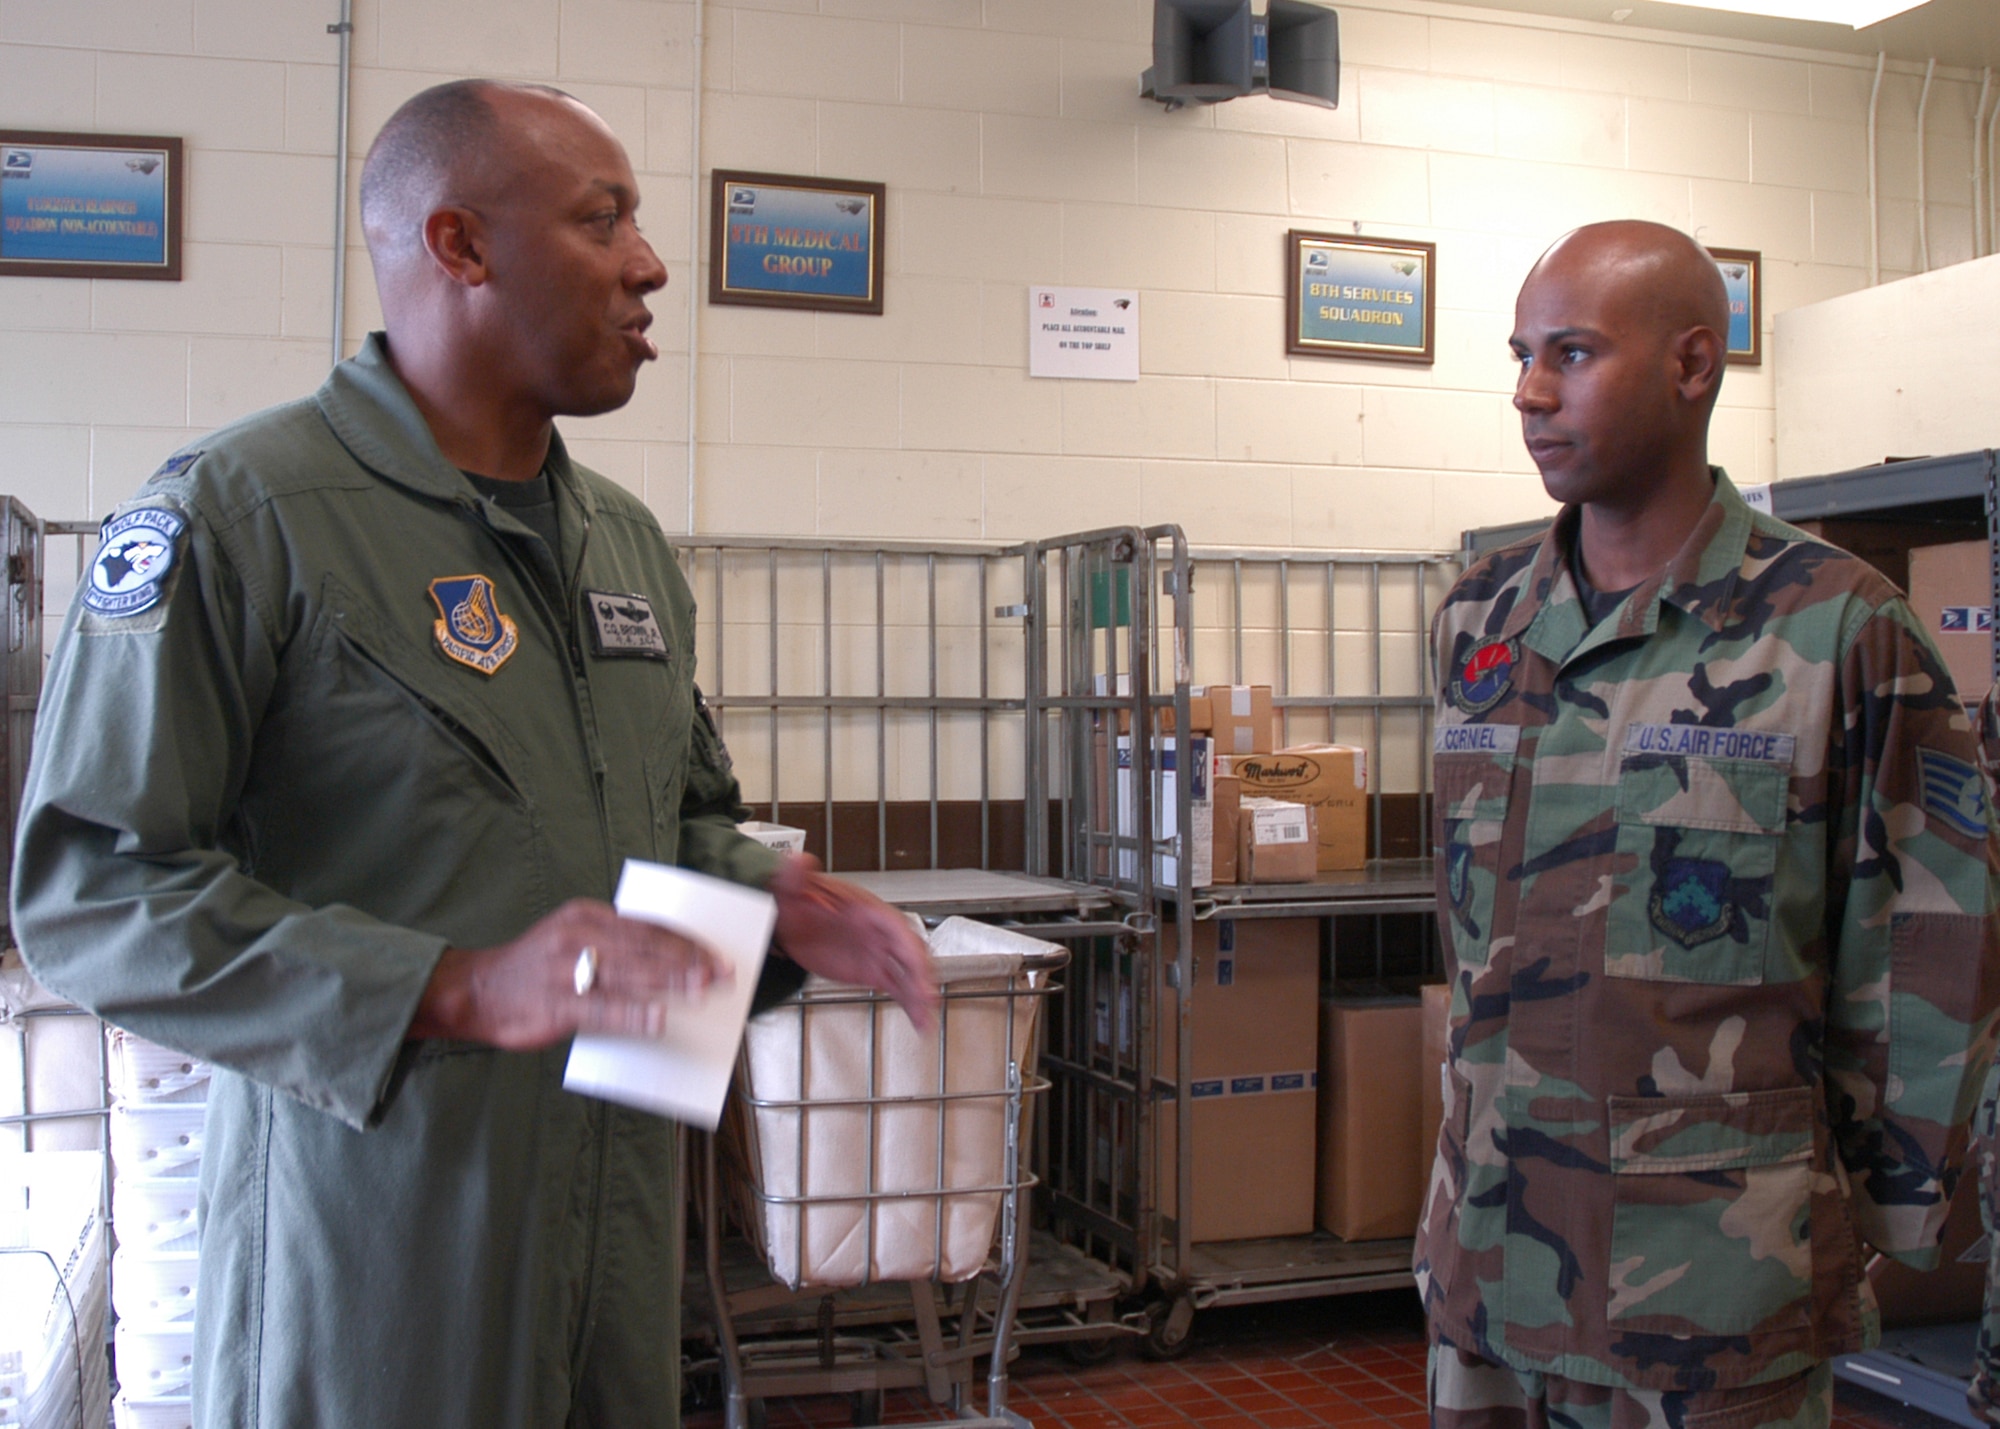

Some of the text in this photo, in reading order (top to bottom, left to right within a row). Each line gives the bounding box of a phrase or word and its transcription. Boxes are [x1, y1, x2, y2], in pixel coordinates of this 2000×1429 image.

[731, 223, 865, 252] 8TH MEDICAL
[763, 253, 833, 277] GROUP
[1310, 283, 1414, 305] 8TH SERVICES
[1320, 306, 1404, 326] SQUADRON
[111, 511, 174, 534] WOLF PACK
[443, 636, 476, 662] PACIFIC
[1677, 728, 1710, 755] AIR
[1714, 732, 1777, 760] FORCE
[1244, 761, 1308, 781] Markwort
